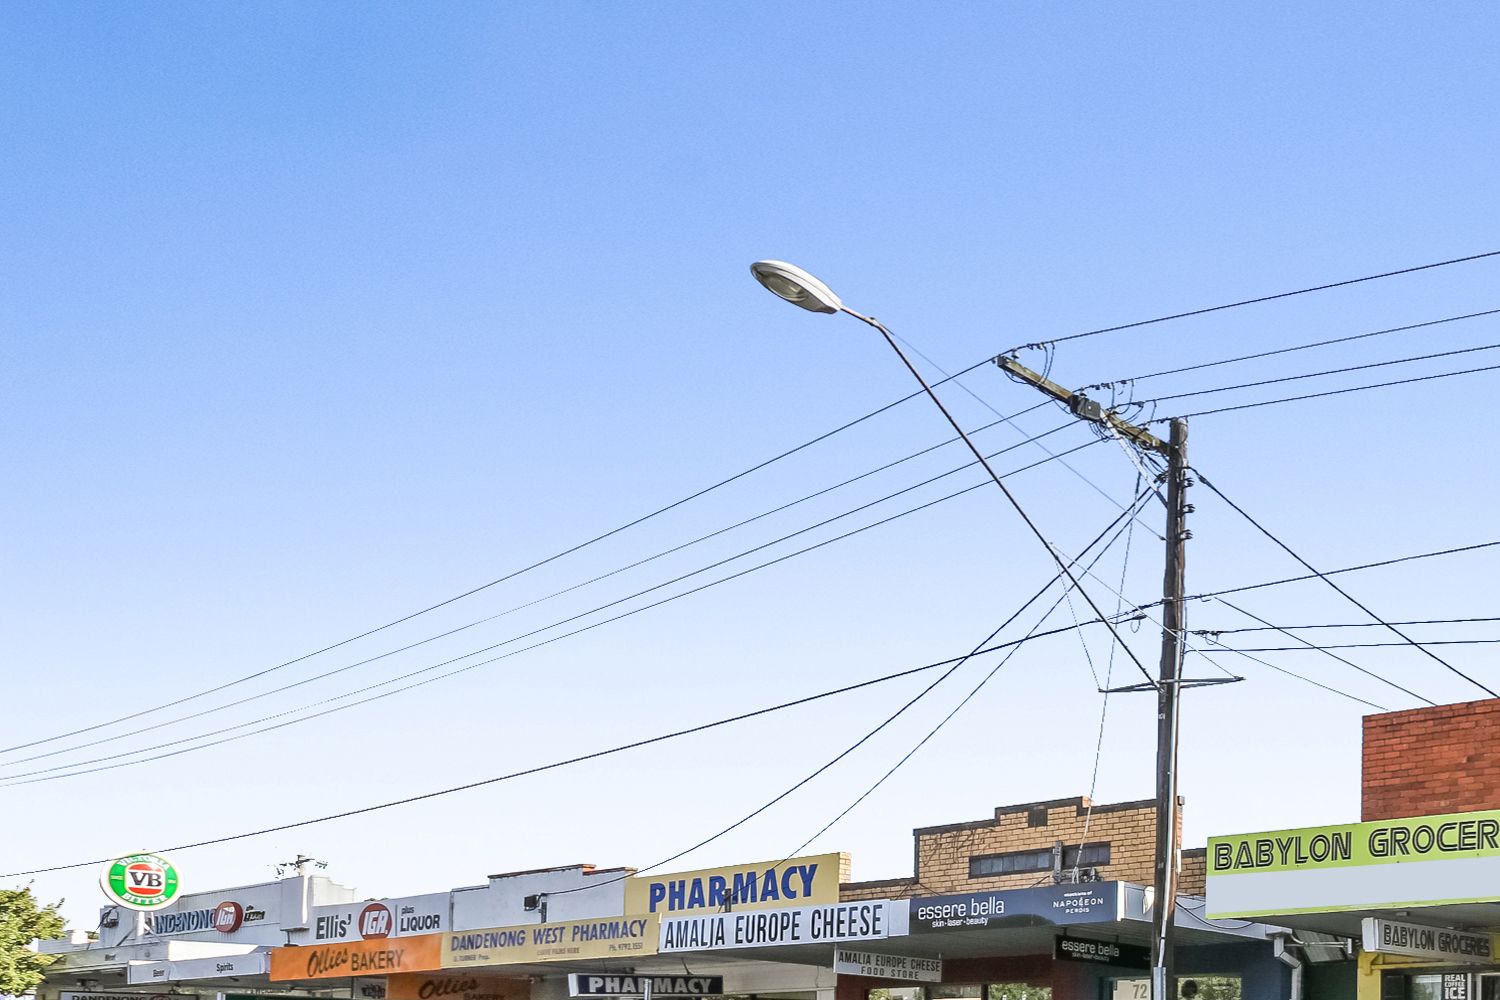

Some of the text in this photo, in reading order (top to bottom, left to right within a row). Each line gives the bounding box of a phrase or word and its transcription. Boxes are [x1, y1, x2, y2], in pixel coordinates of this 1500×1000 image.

[1213, 832, 1352, 872] BABYLON
[117, 854, 169, 871] VICTORIA
[129, 871, 162, 887] VB
[649, 864, 818, 913] PHARMACY
[121, 892, 169, 905] BITTER
[401, 905, 415, 916] plus
[918, 896, 1005, 920] essere bella
[316, 910, 389, 939] Ellis' IGA
[401, 914, 440, 932] LIQUOR
[735, 911, 802, 944] EUROPE
[811, 904, 883, 940] CHEESE
[451, 919, 648, 951] DANDENONG WEST PHARMACY
[1384, 924, 1490, 957] BABYLON GROCERIES
[1062, 940, 1120, 958] essere bella
[216, 962, 234, 973] Spirits
[307, 948, 404, 978] Ollies BAKERY
[839, 951, 940, 972] AMALIA EUROPE CHEESE
[861, 966, 919, 980] FOOD STORE
[1444, 974, 1466, 982] REAL
[418, 977, 480, 999] Ollies
[1133, 984, 1147, 999] 72
[1444, 987, 1466, 1000] ICE
